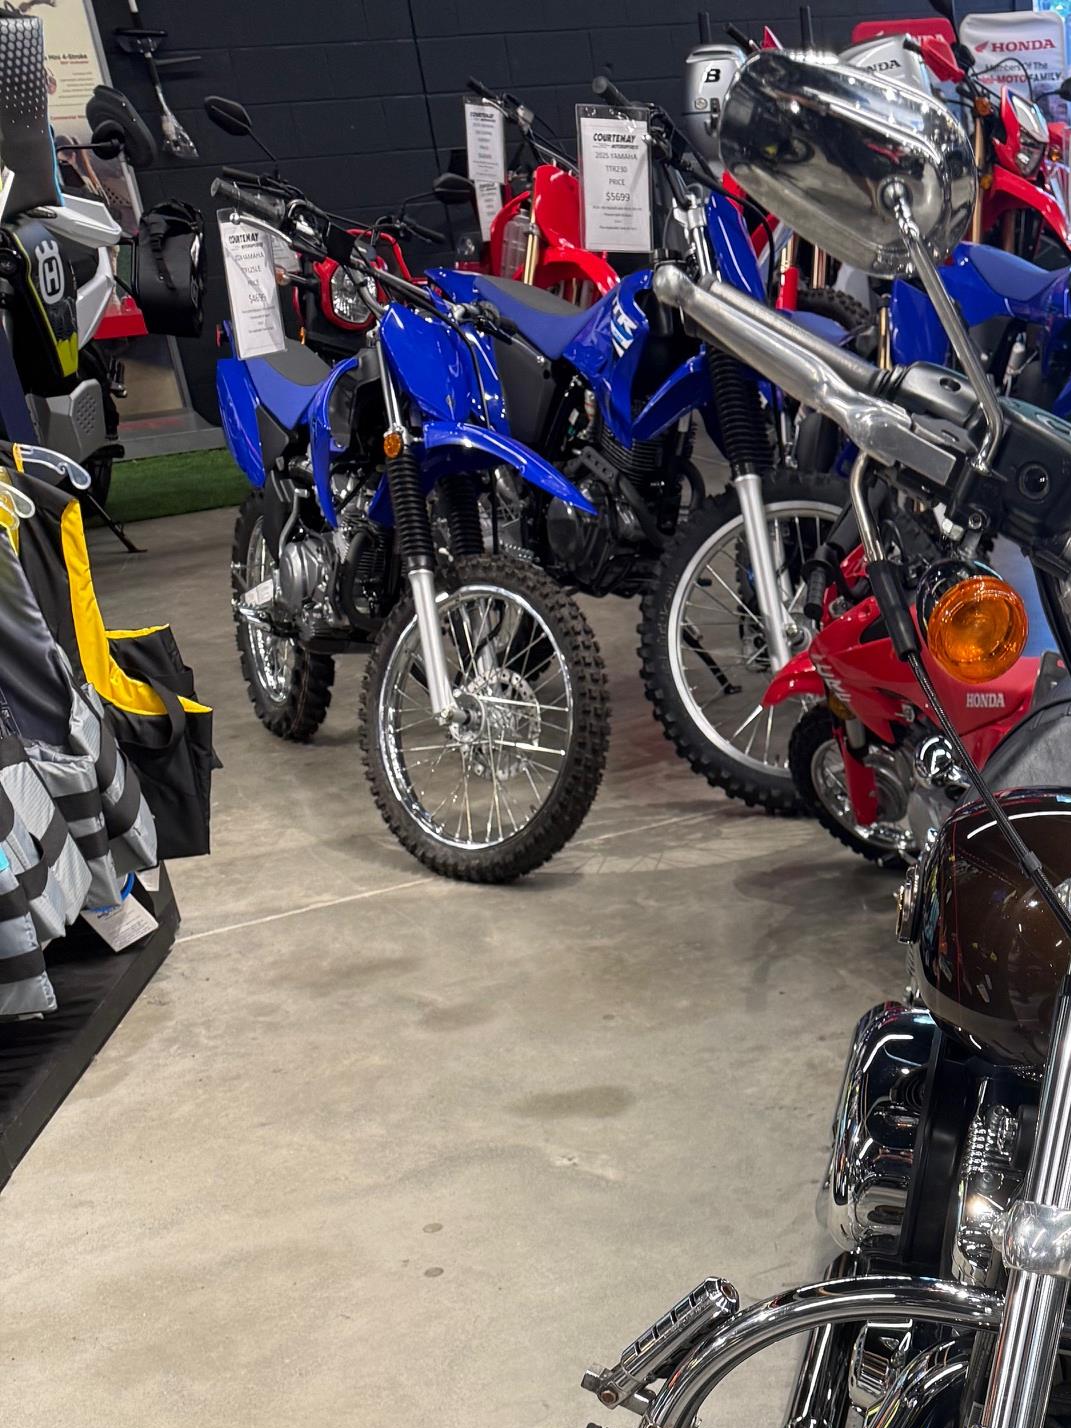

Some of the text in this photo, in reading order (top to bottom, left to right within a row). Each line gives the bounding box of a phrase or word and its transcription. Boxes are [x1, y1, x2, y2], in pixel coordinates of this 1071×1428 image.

[991, 39, 1056, 52] HONDA
[866, 60, 901, 72] NDA
[593, 133, 636, 143] COURTENAY
[610, 152, 638, 160] YAMAHA
[609, 178, 625, 186] PRICE
[229, 233, 258, 244] COURTENAY
[966, 693, 1005, 708] HONDA
